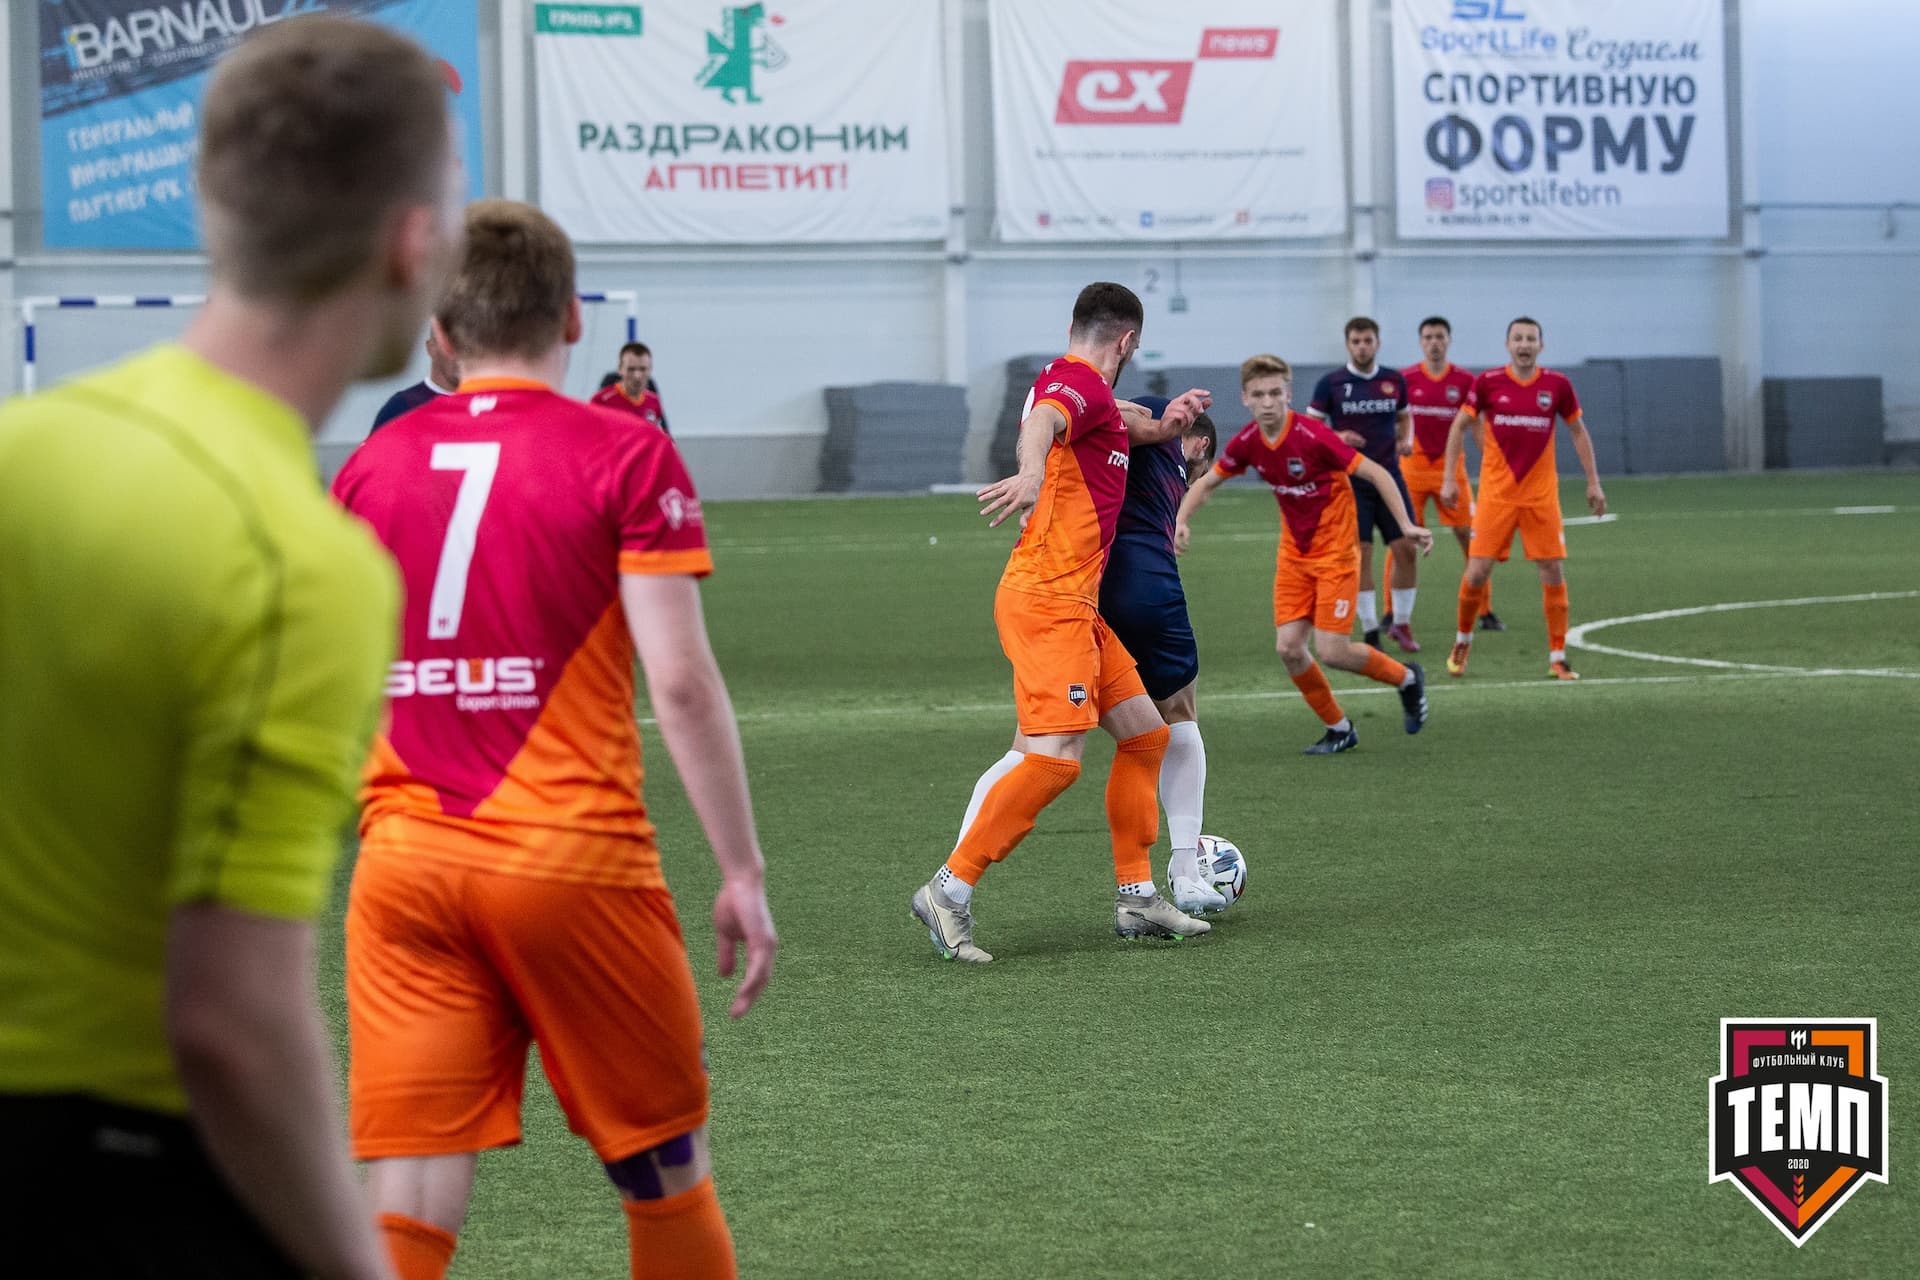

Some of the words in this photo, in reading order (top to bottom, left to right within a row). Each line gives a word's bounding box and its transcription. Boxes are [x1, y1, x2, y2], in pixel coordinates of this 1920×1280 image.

[1208, 34, 1268, 52] news
[1421, 26, 1557, 52] SportLife
[1566, 27, 1701, 68] Создаем
[1423, 72, 1697, 105] СПОРТИВНУЮ
[578, 122, 909, 157] РАЗДРАКОНИМ
[1425, 113, 1696, 173] ФОРМУ
[643, 164, 848, 191] АППЕТИТ!
[1459, 178, 1622, 209] sportlifebrn
[1143, 268, 1160, 294] 2
[429, 441, 501, 640] 7
[501, 693, 540, 711] Union
